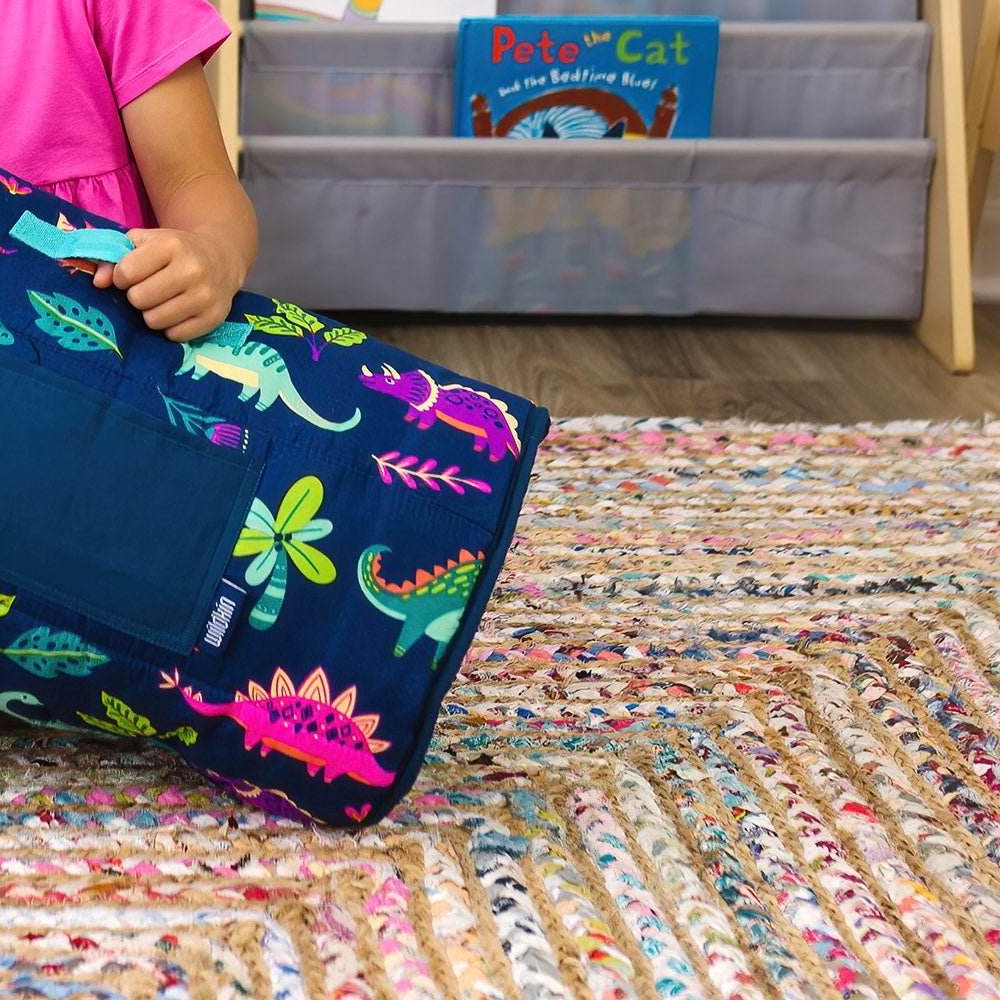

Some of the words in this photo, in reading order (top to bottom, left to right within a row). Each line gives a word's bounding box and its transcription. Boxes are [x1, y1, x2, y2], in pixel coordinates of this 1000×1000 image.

[491, 25, 579, 64] Pete
[583, 31, 611, 48] the
[616, 29, 690, 65] Cat
[498, 80, 521, 97] and
[524, 74, 546, 90] the
[550, 66, 617, 85] Bedtime
[204, 596, 236, 648] wildkin
